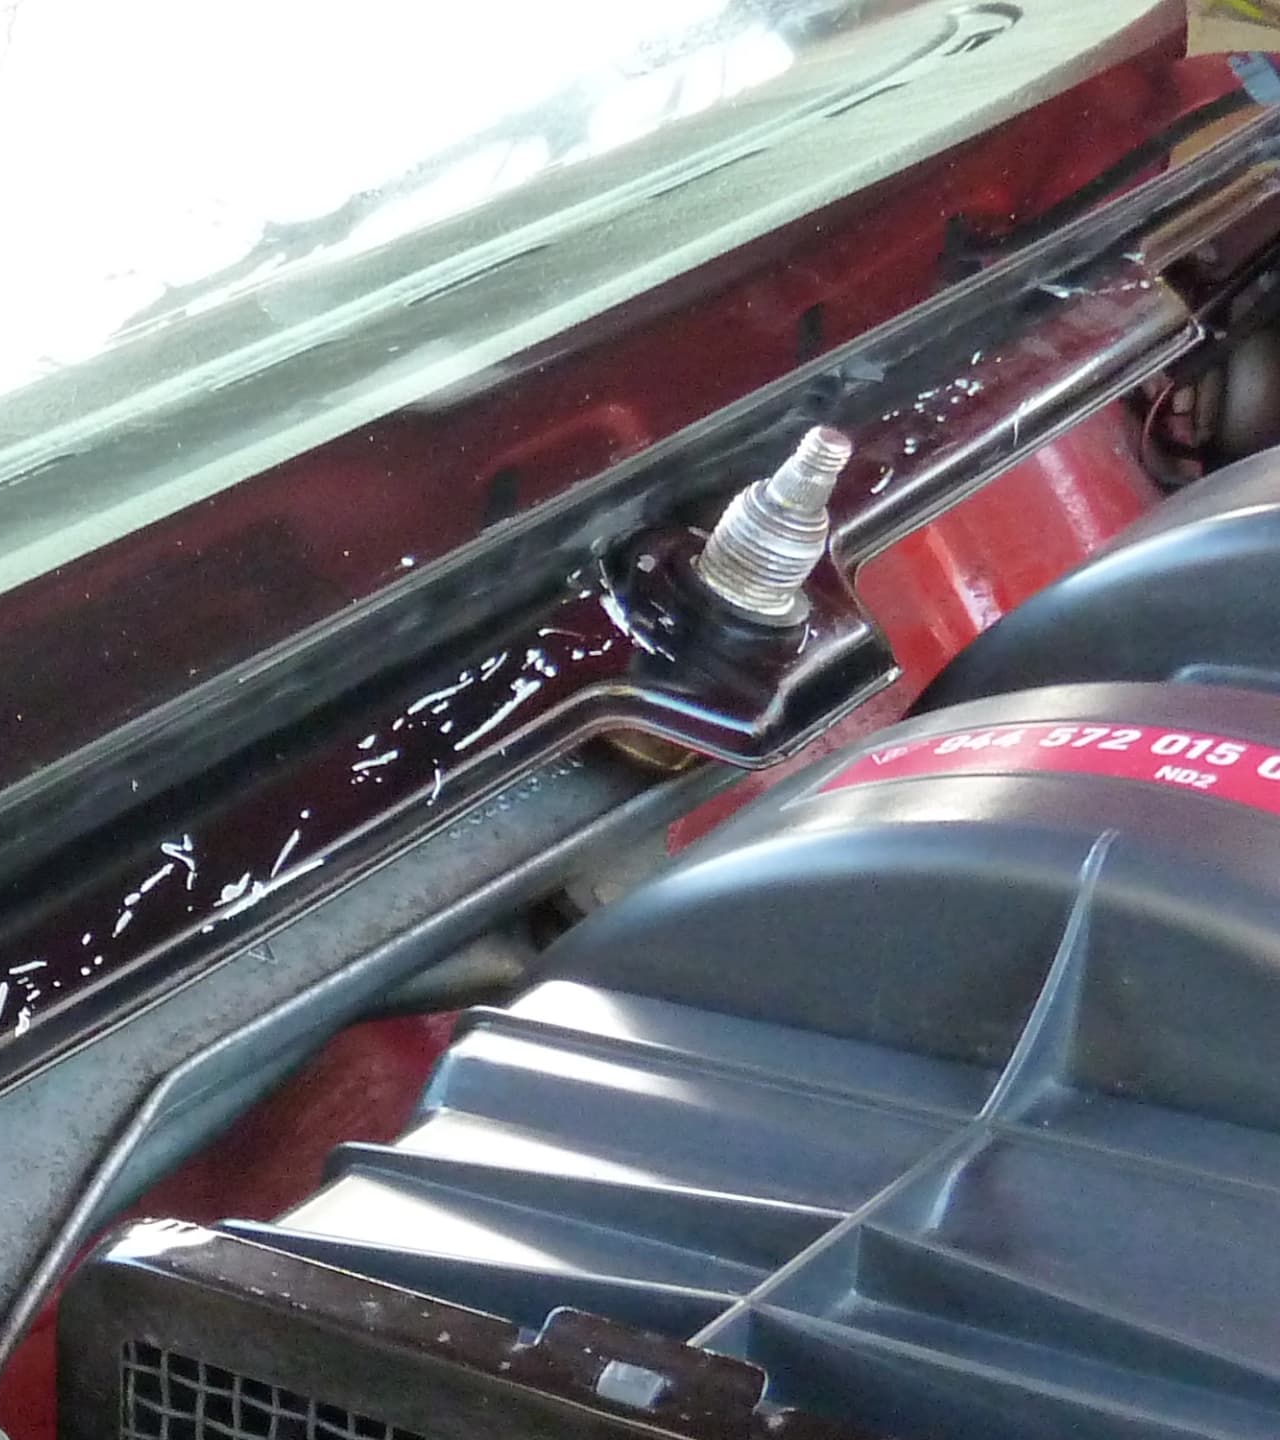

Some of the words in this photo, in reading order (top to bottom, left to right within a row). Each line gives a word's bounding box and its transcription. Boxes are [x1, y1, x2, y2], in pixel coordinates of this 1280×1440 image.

[933, 729, 1021, 755] 944
[1040, 727, 1142, 751] 572
[1150, 734, 1246, 766] 015
[1154, 765, 1217, 789] ND2
